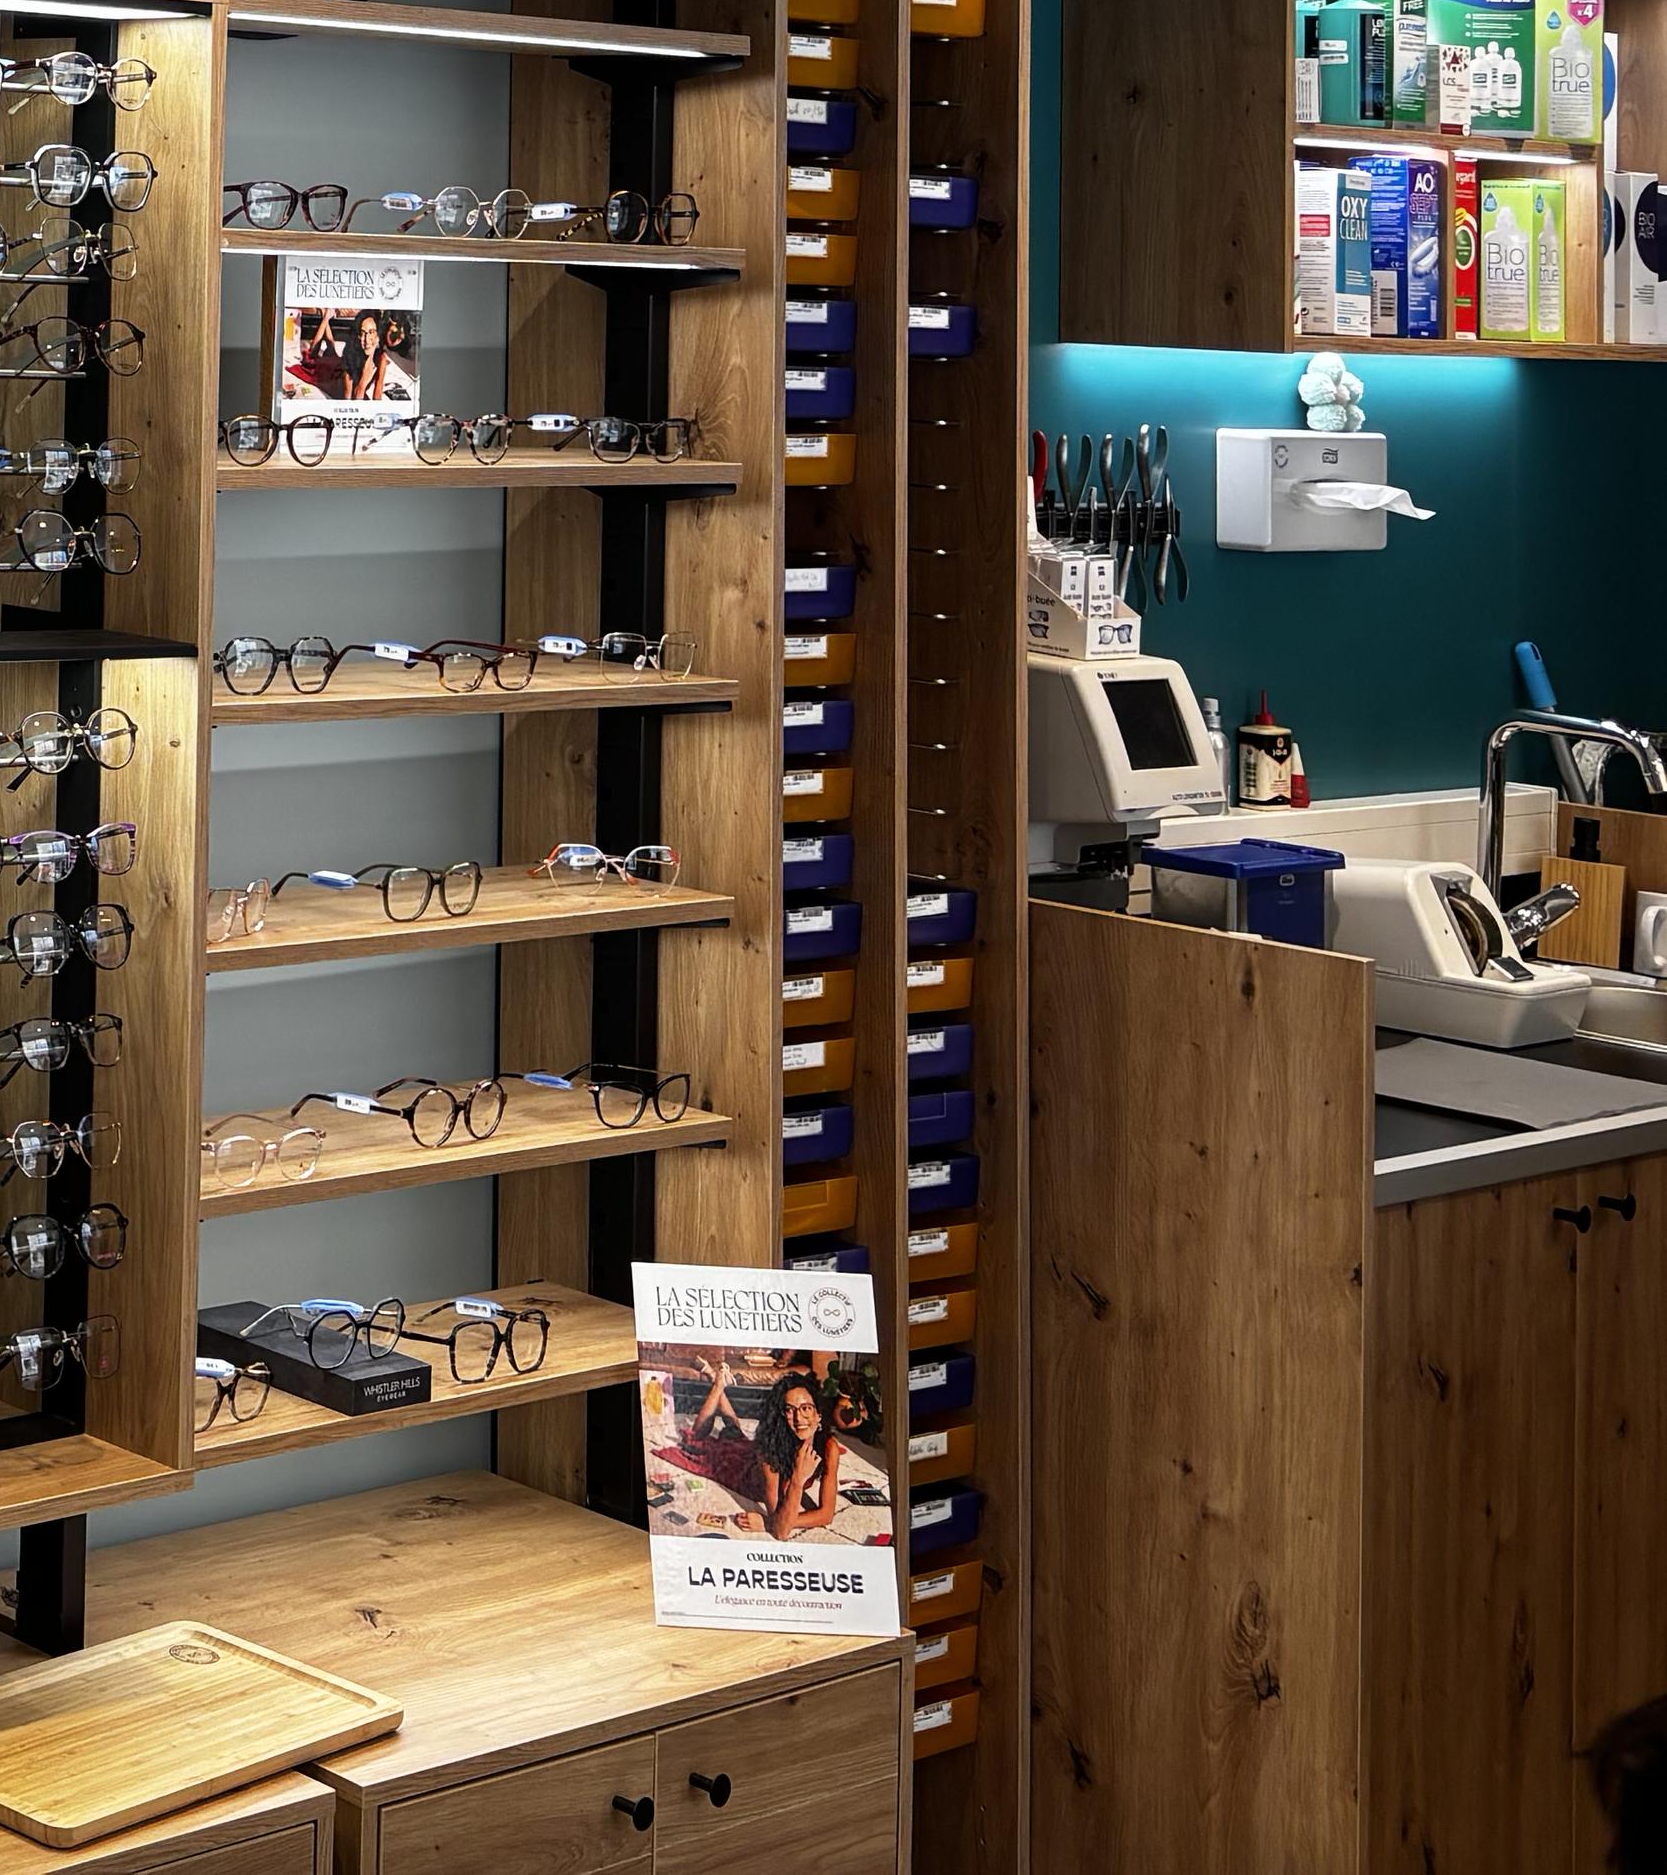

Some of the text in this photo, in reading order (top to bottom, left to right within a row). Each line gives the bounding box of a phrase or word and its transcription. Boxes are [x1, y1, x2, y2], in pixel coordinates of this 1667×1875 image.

[1552, 57, 1590, 78] Bio
[1552, 77, 1590, 93] true
[1414, 172, 1434, 193] AO
[1341, 195, 1368, 219] OXY
[1339, 218, 1368, 241] CLEAN
[1487, 242, 1525, 266] Bio
[296, 268, 313, 283] LA
[1487, 266, 1526, 282] true
[296, 283, 317, 298] DES
[656, 1285, 800, 1313] LA SÉLECTION
[658, 1308, 803, 1333] DES LUNETIERS
[364, 1377, 421, 1396] WHISTLER HILLS
[747, 1553, 803, 1563] COLLECTION
[688, 1566, 864, 1594] LA PARESSEUSE
